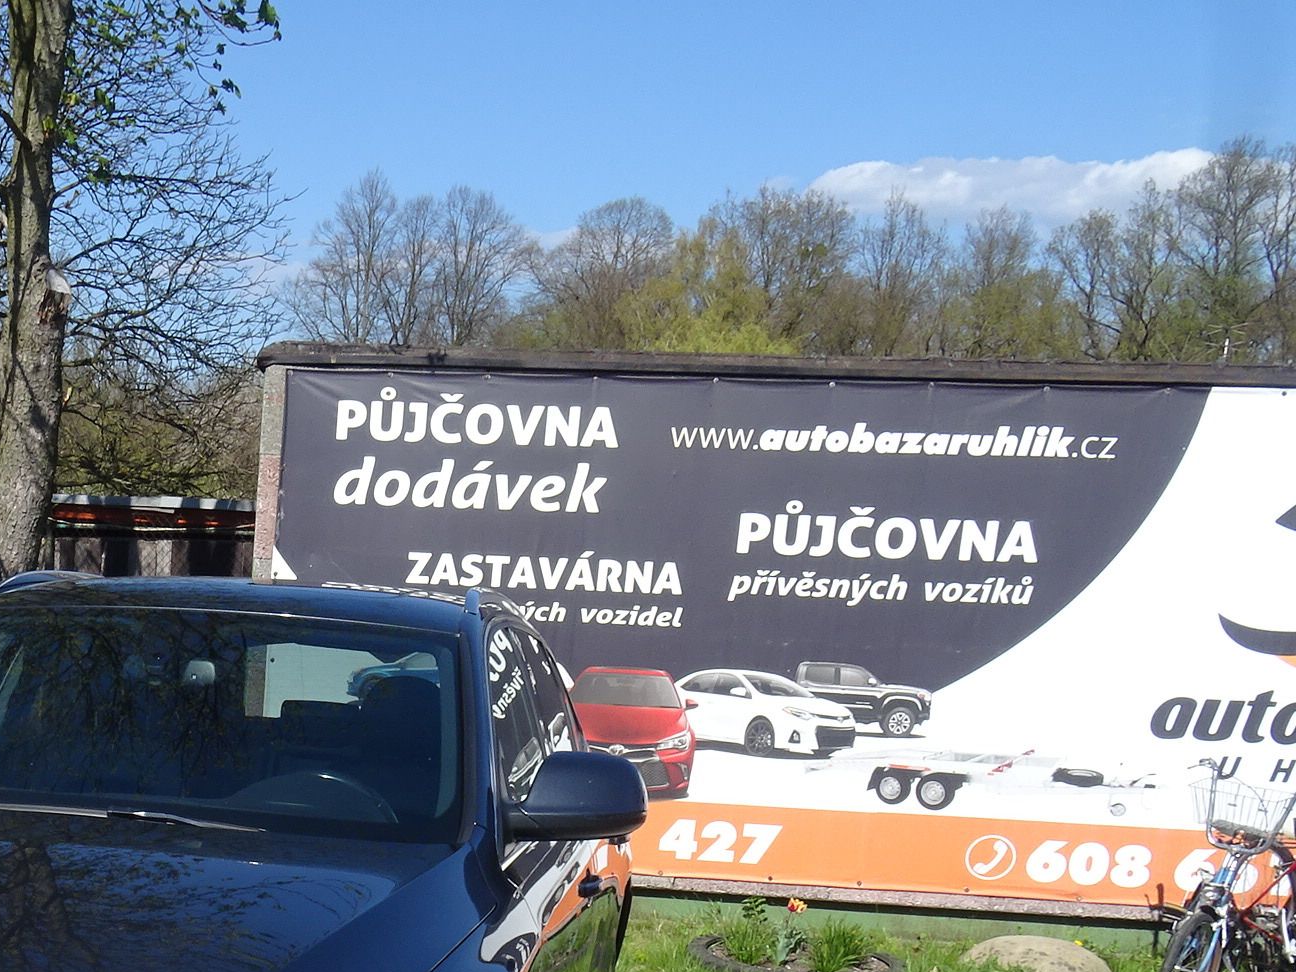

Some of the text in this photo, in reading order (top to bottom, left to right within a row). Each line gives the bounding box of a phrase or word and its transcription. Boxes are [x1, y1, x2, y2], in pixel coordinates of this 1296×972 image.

[334, 386, 620, 449] PŮJČOVNA
[670, 422, 1120, 461] www.autobazaruhlik.cz
[333, 456, 608, 514] dodávek
[735, 500, 1040, 564] PŮJČOVNA
[405, 550, 683, 596] ZASTAVÁRNA
[727, 568, 1035, 607] přívěsných vozíků
[518, 601, 684, 628] ých vozidel
[658, 818, 784, 865] 427
[1025, 839, 1153, 889] 608
